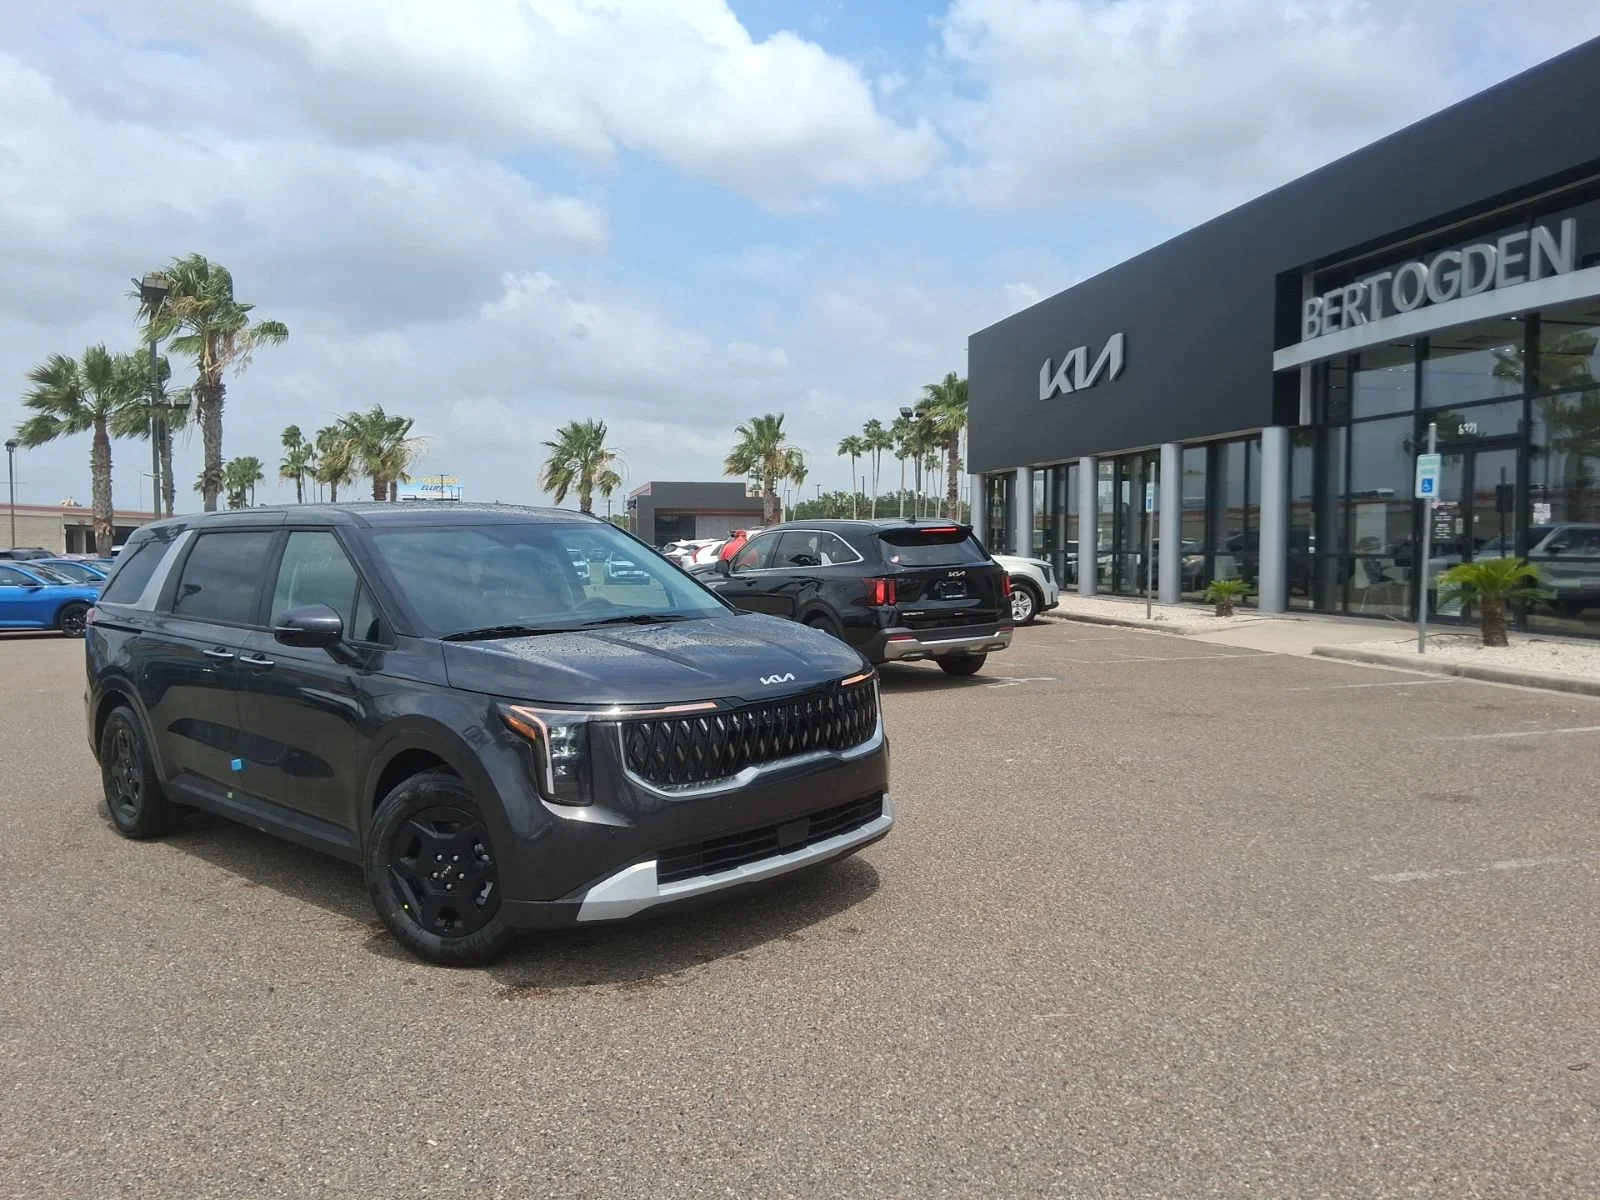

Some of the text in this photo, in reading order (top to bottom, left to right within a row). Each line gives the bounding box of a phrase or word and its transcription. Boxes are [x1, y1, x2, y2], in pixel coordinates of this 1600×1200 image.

[1302, 218, 1576, 342] BERT OGDEN
[1039, 332, 1124, 401] KIA
[760, 672, 795, 685] KIA
